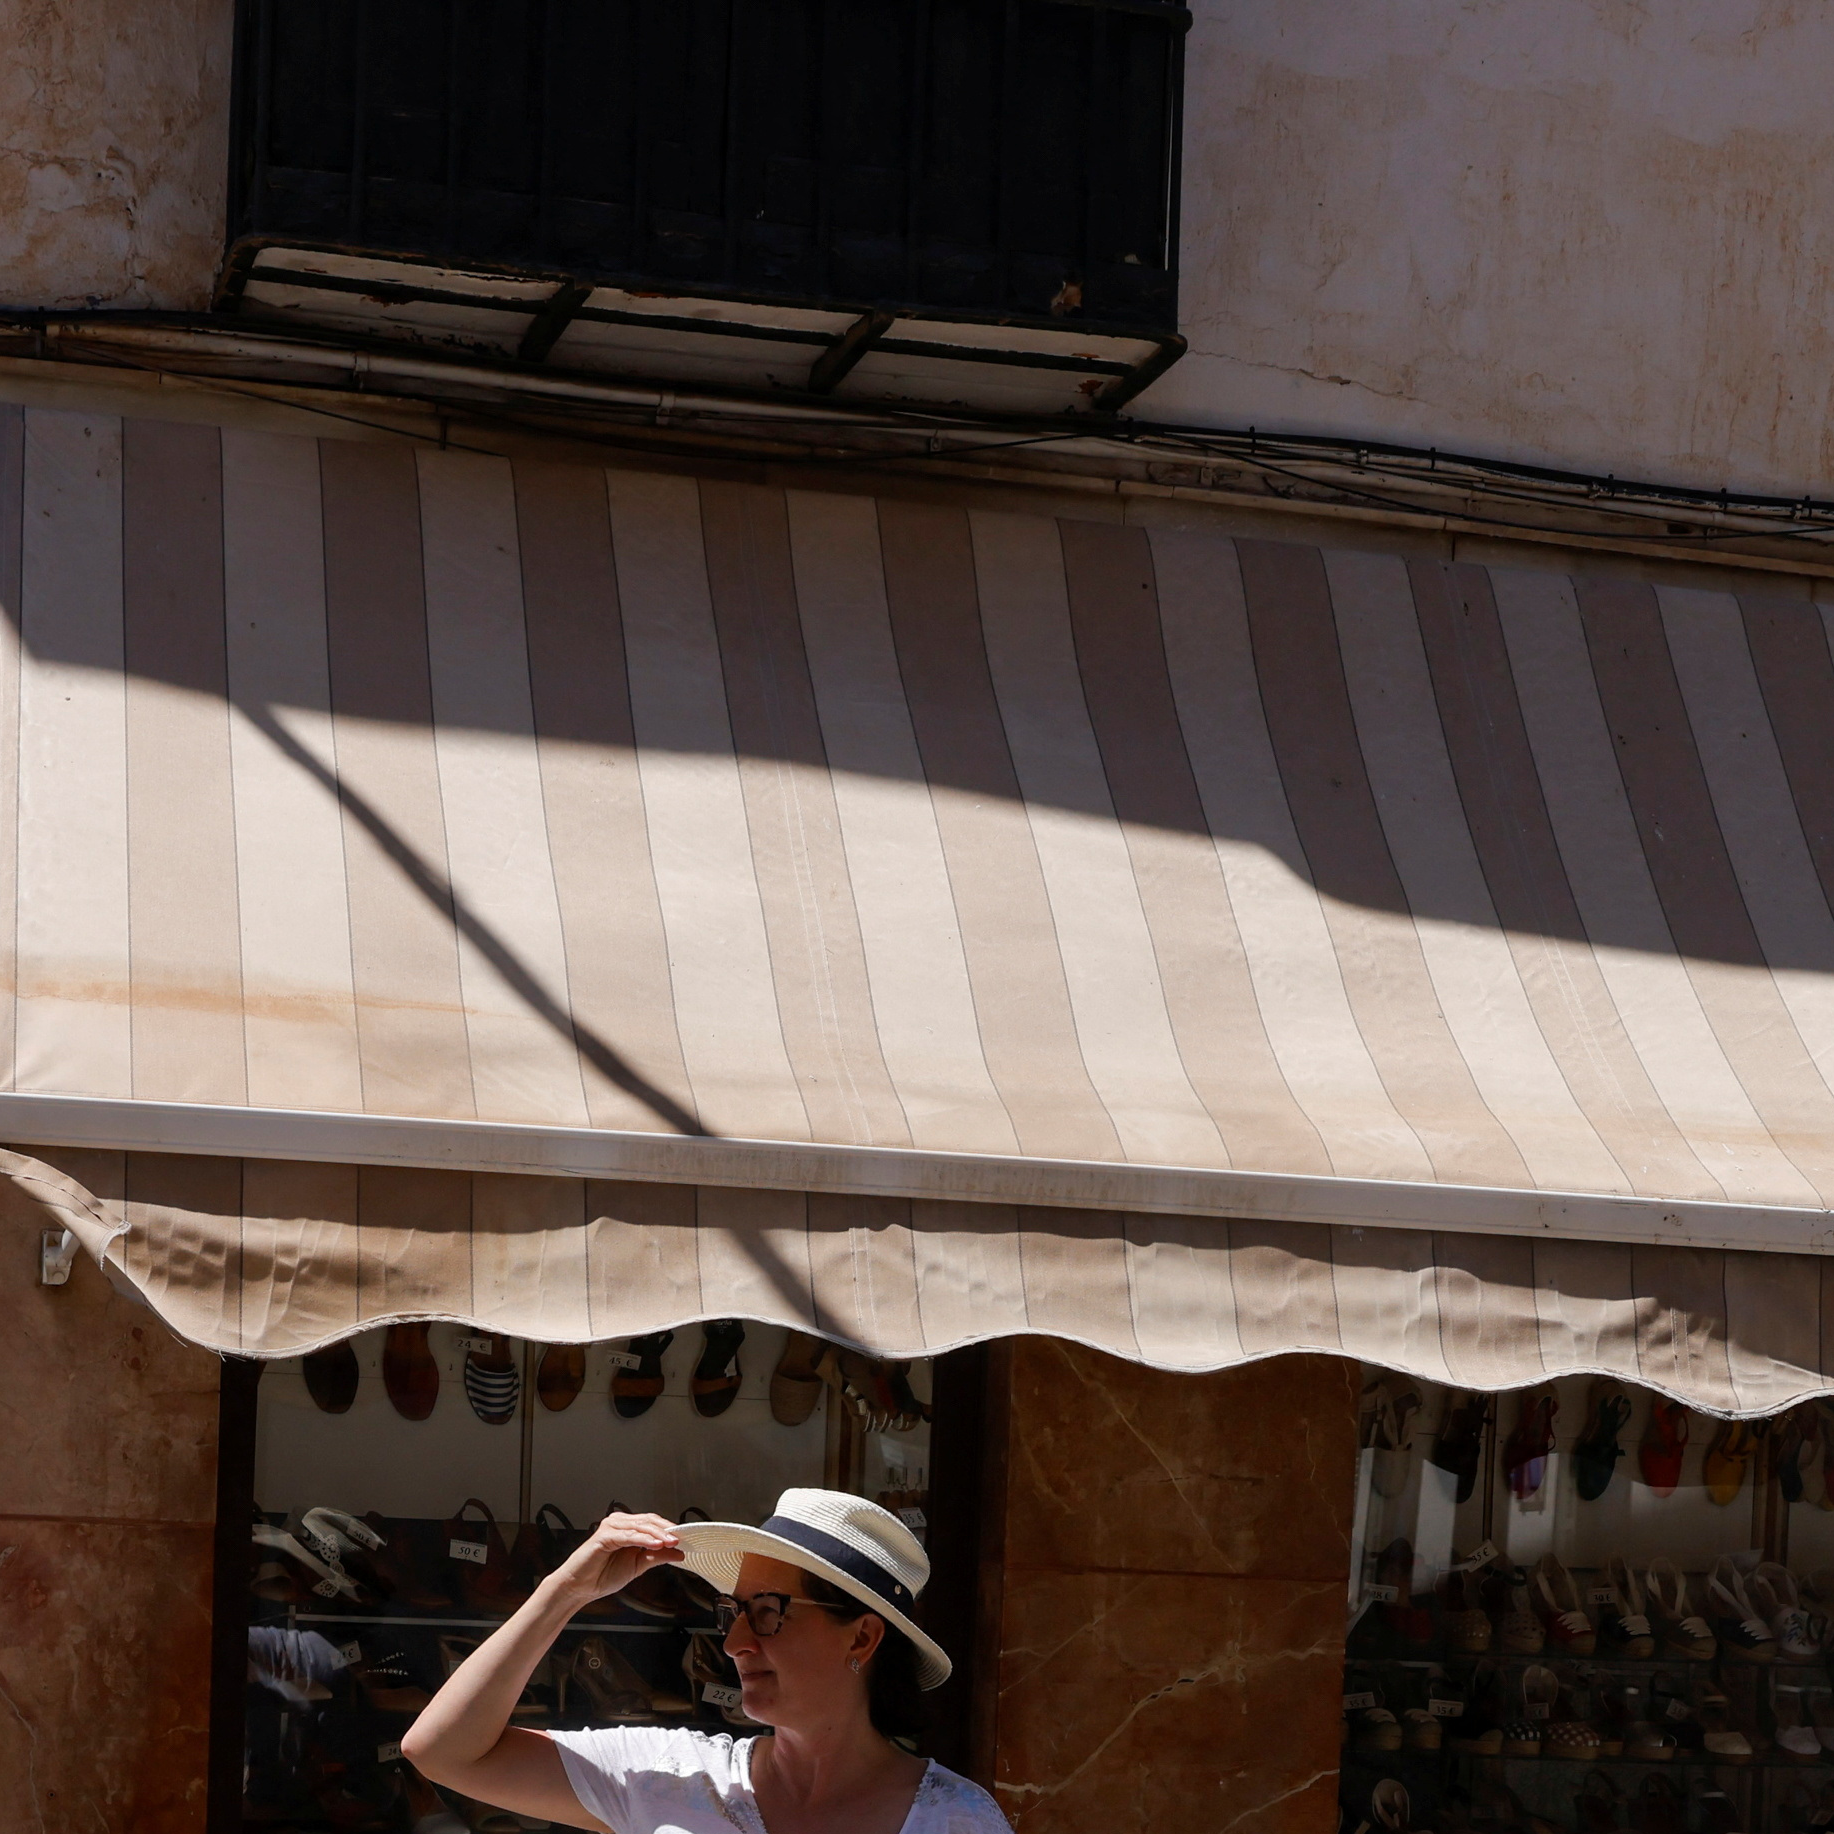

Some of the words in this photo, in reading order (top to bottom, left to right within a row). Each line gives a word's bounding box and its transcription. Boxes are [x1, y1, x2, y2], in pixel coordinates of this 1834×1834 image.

[457, 1340, 471, 1349] 24
[609, 1357, 621, 1365] 45
[458, 1546, 470, 1555] 50
[1472, 1553, 1482, 1564] 35
[712, 1690, 726, 1700] 22
[1437, 1706, 1447, 1715] 35
